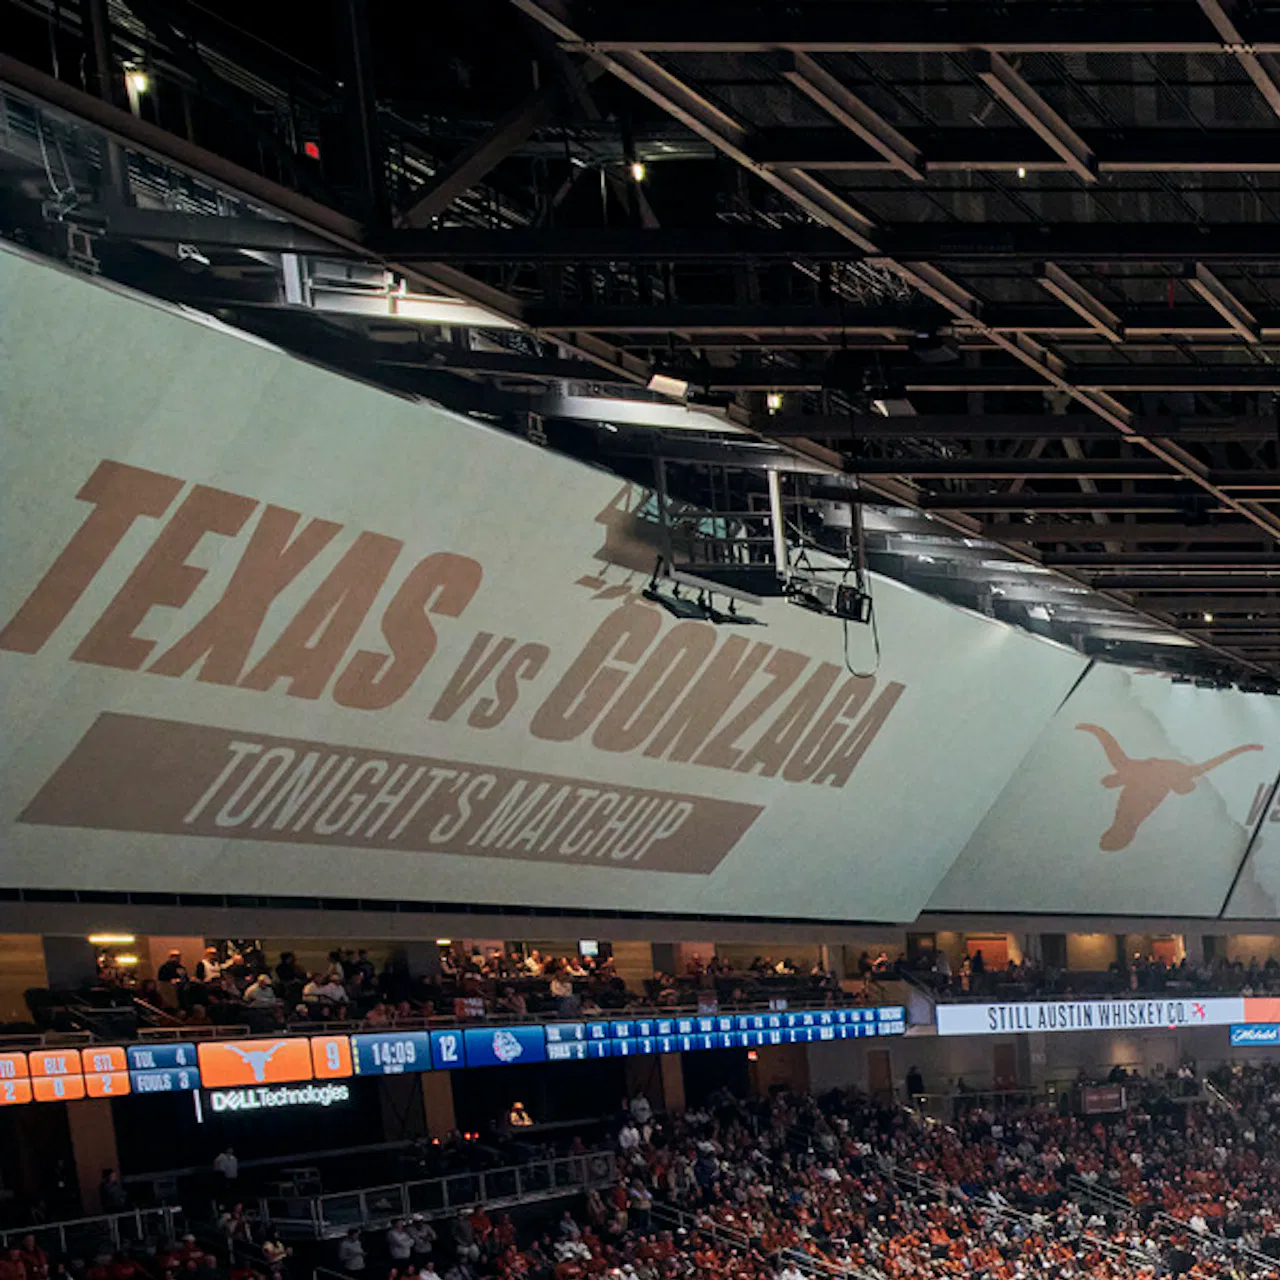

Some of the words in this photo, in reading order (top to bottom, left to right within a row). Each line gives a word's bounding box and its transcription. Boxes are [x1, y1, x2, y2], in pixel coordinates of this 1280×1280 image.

[0, 459, 482, 711] TEXAS
[430, 631, 545, 730] VS
[529, 608, 906, 788] GONZAGA
[185, 741, 494, 844] TONIGHT'S
[466, 775, 695, 861] MATCHUP
[988, 1007, 1031, 1030] STILL
[1038, 1005, 1094, 1029] AUSTIN
[1097, 1002, 1164, 1027] WHISKEY
[1165, 1001, 1190, 1024] CO.
[175, 1047, 187, 1066] 4
[326, 1042, 340, 1070] 9
[372, 1040, 417, 1066] 14:09
[438, 1035, 458, 1062] 12
[43, 1057, 68, 1075] BLK
[92, 1054, 115, 1071] STL
[4, 1081, 17, 1100] 2
[102, 1074, 113, 1093] 2
[137, 1072, 172, 1092] FOULS
[178, 1070, 189, 1090] 3
[211, 1087, 262, 1111] DELL
[256, 1082, 350, 1107] Technologies
